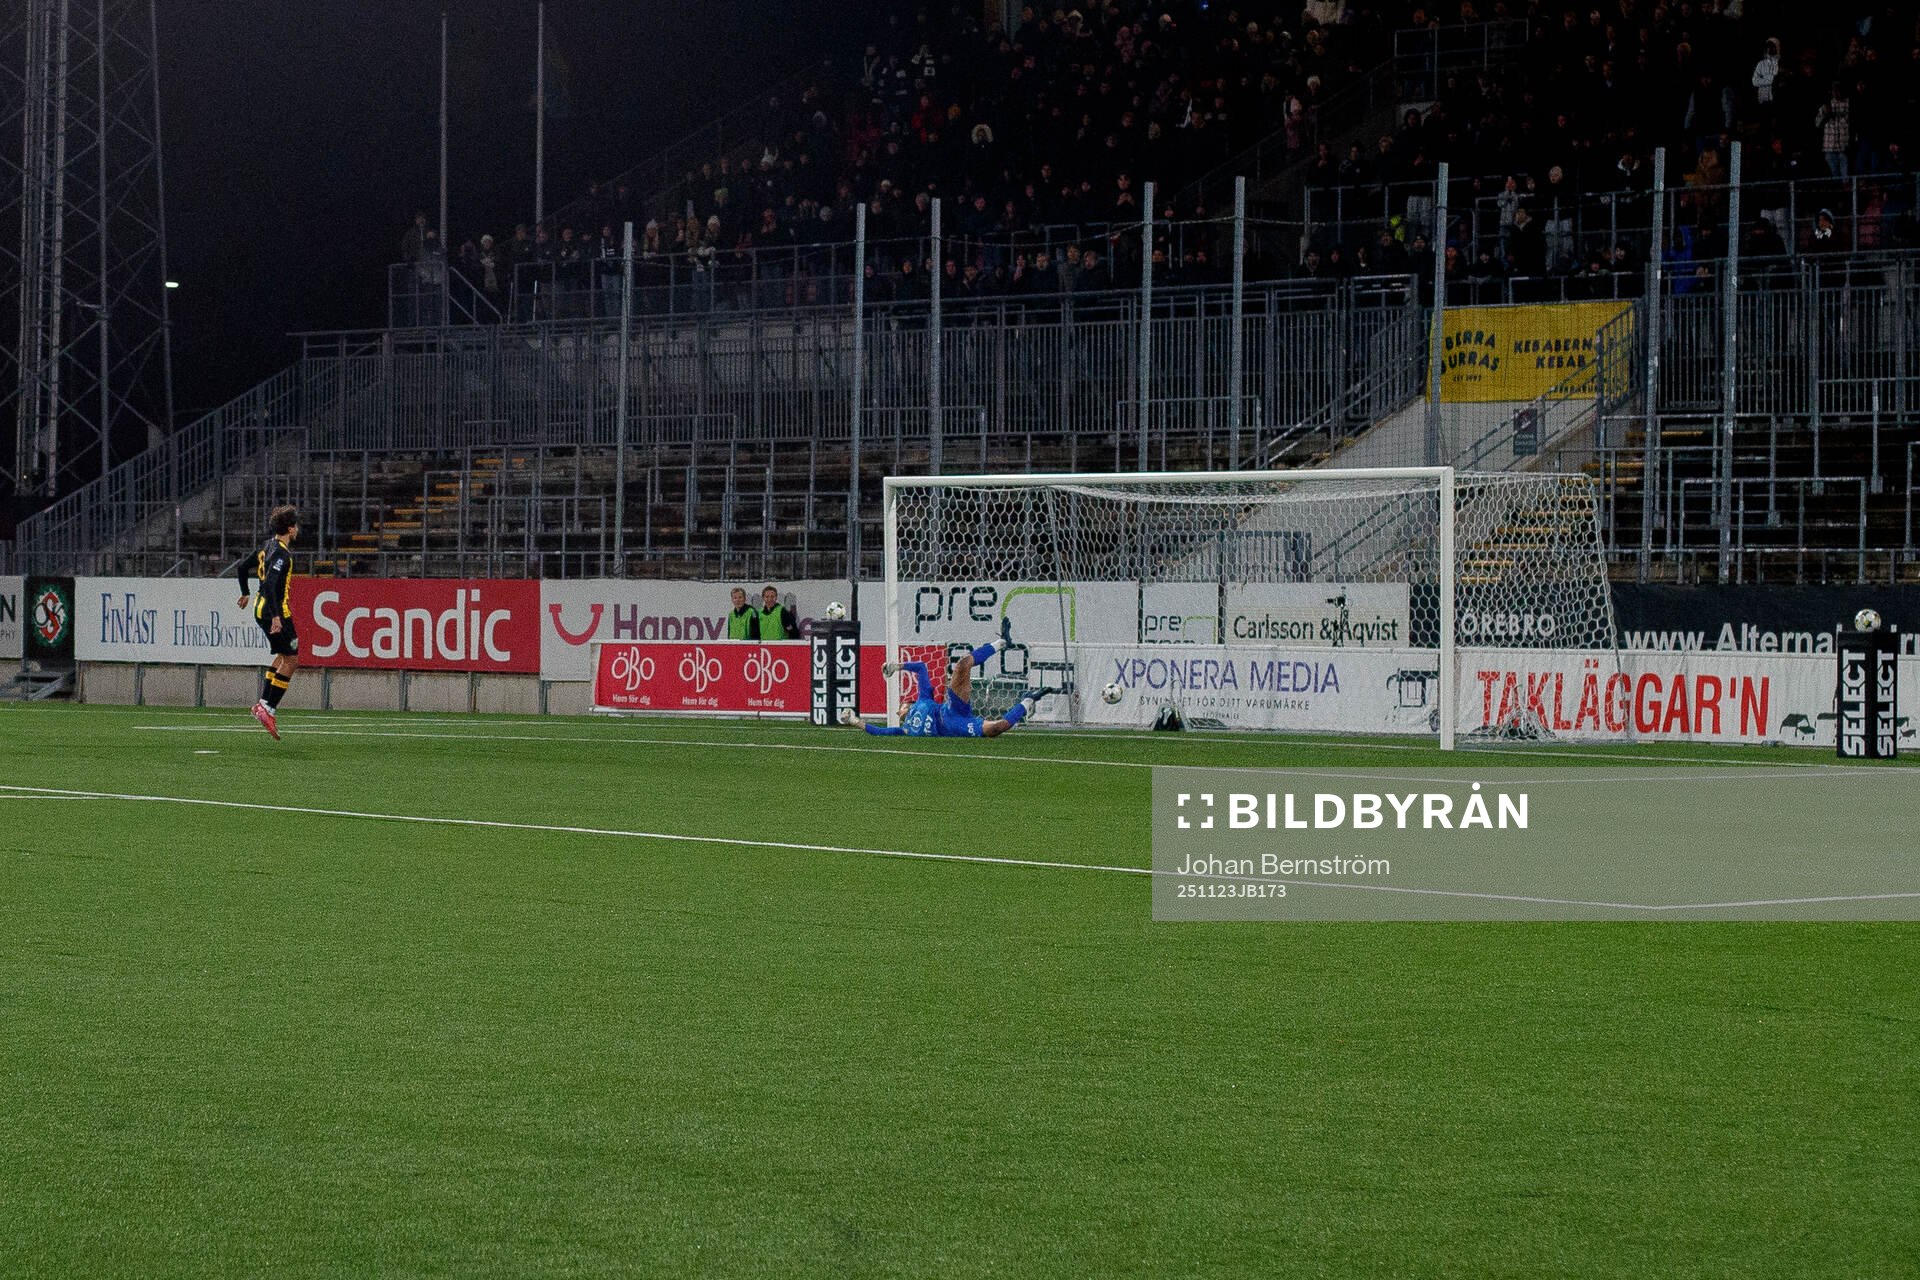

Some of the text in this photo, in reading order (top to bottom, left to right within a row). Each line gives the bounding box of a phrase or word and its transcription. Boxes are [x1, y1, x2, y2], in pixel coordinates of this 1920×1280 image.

[311, 588, 512, 663] Scandic
[914, 585, 998, 634] pre
[1233, 613, 1315, 642] Carlsson
[1320, 618, 1334, 641] &
[611, 646, 655, 691] ÖBO
[679, 647, 723, 693] ÖBO
[744, 648, 790, 695] ÖBO
[813, 636, 827, 725] SELECT
[836, 636, 856, 725] SELECT
[1115, 658, 1340, 694] XPONERA MEDIA
[612, 694, 627, 703] Hem
[640, 695, 651, 706] dig
[682, 696, 697, 705] Hem
[707, 697, 719, 707] dig
[747, 697, 762, 706] Hem
[774, 698, 785, 708] dig
[1246, 698, 1310, 711] VARUMÄRKE
[1477, 658, 1770, 737] TAKLÄGGAR'N
[1842, 650, 1866, 757] SELECT
[1877, 650, 1894, 757] SELECT
